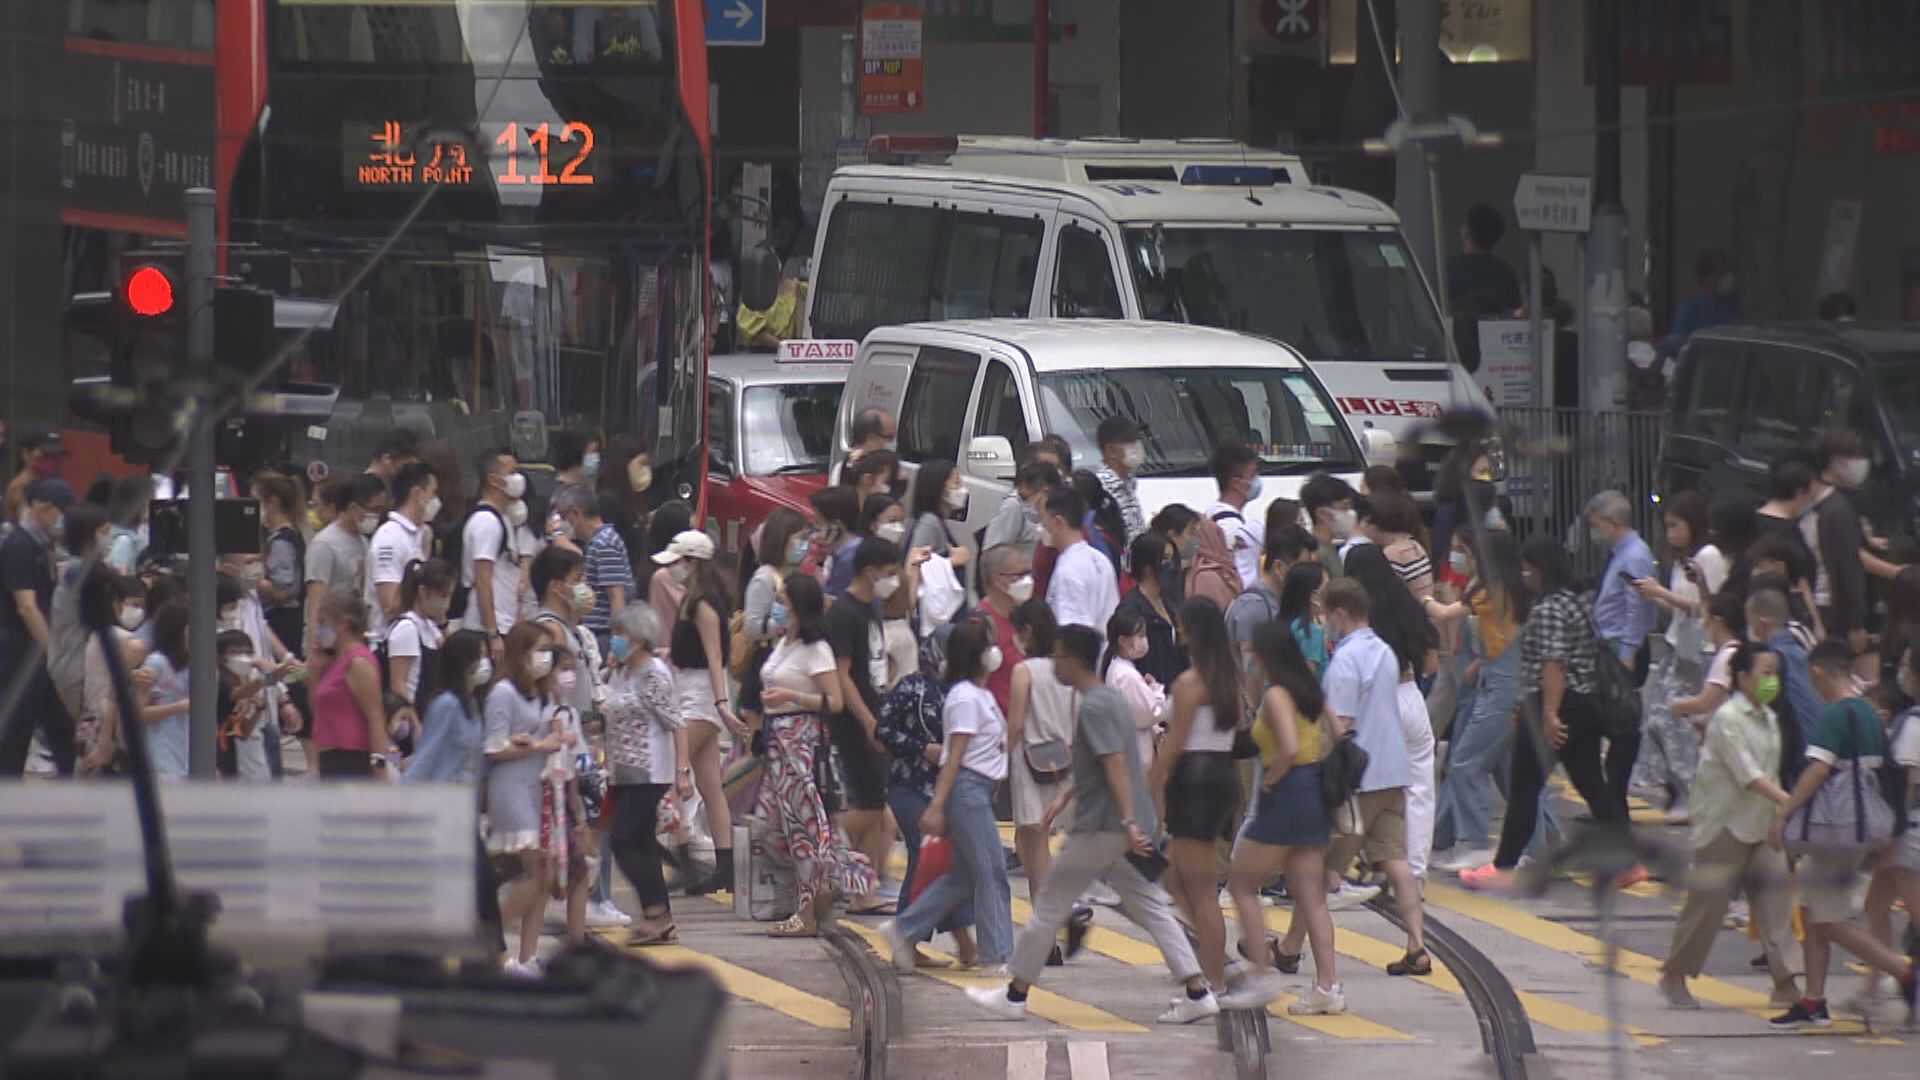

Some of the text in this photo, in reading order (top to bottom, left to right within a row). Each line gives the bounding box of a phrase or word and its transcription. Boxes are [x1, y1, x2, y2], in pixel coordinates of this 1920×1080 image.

[496, 121, 594, 184] 112
[358, 166, 412, 184] NORTH
[787, 343, 853, 358] TAXI
[1342, 398, 1419, 416] LICE
